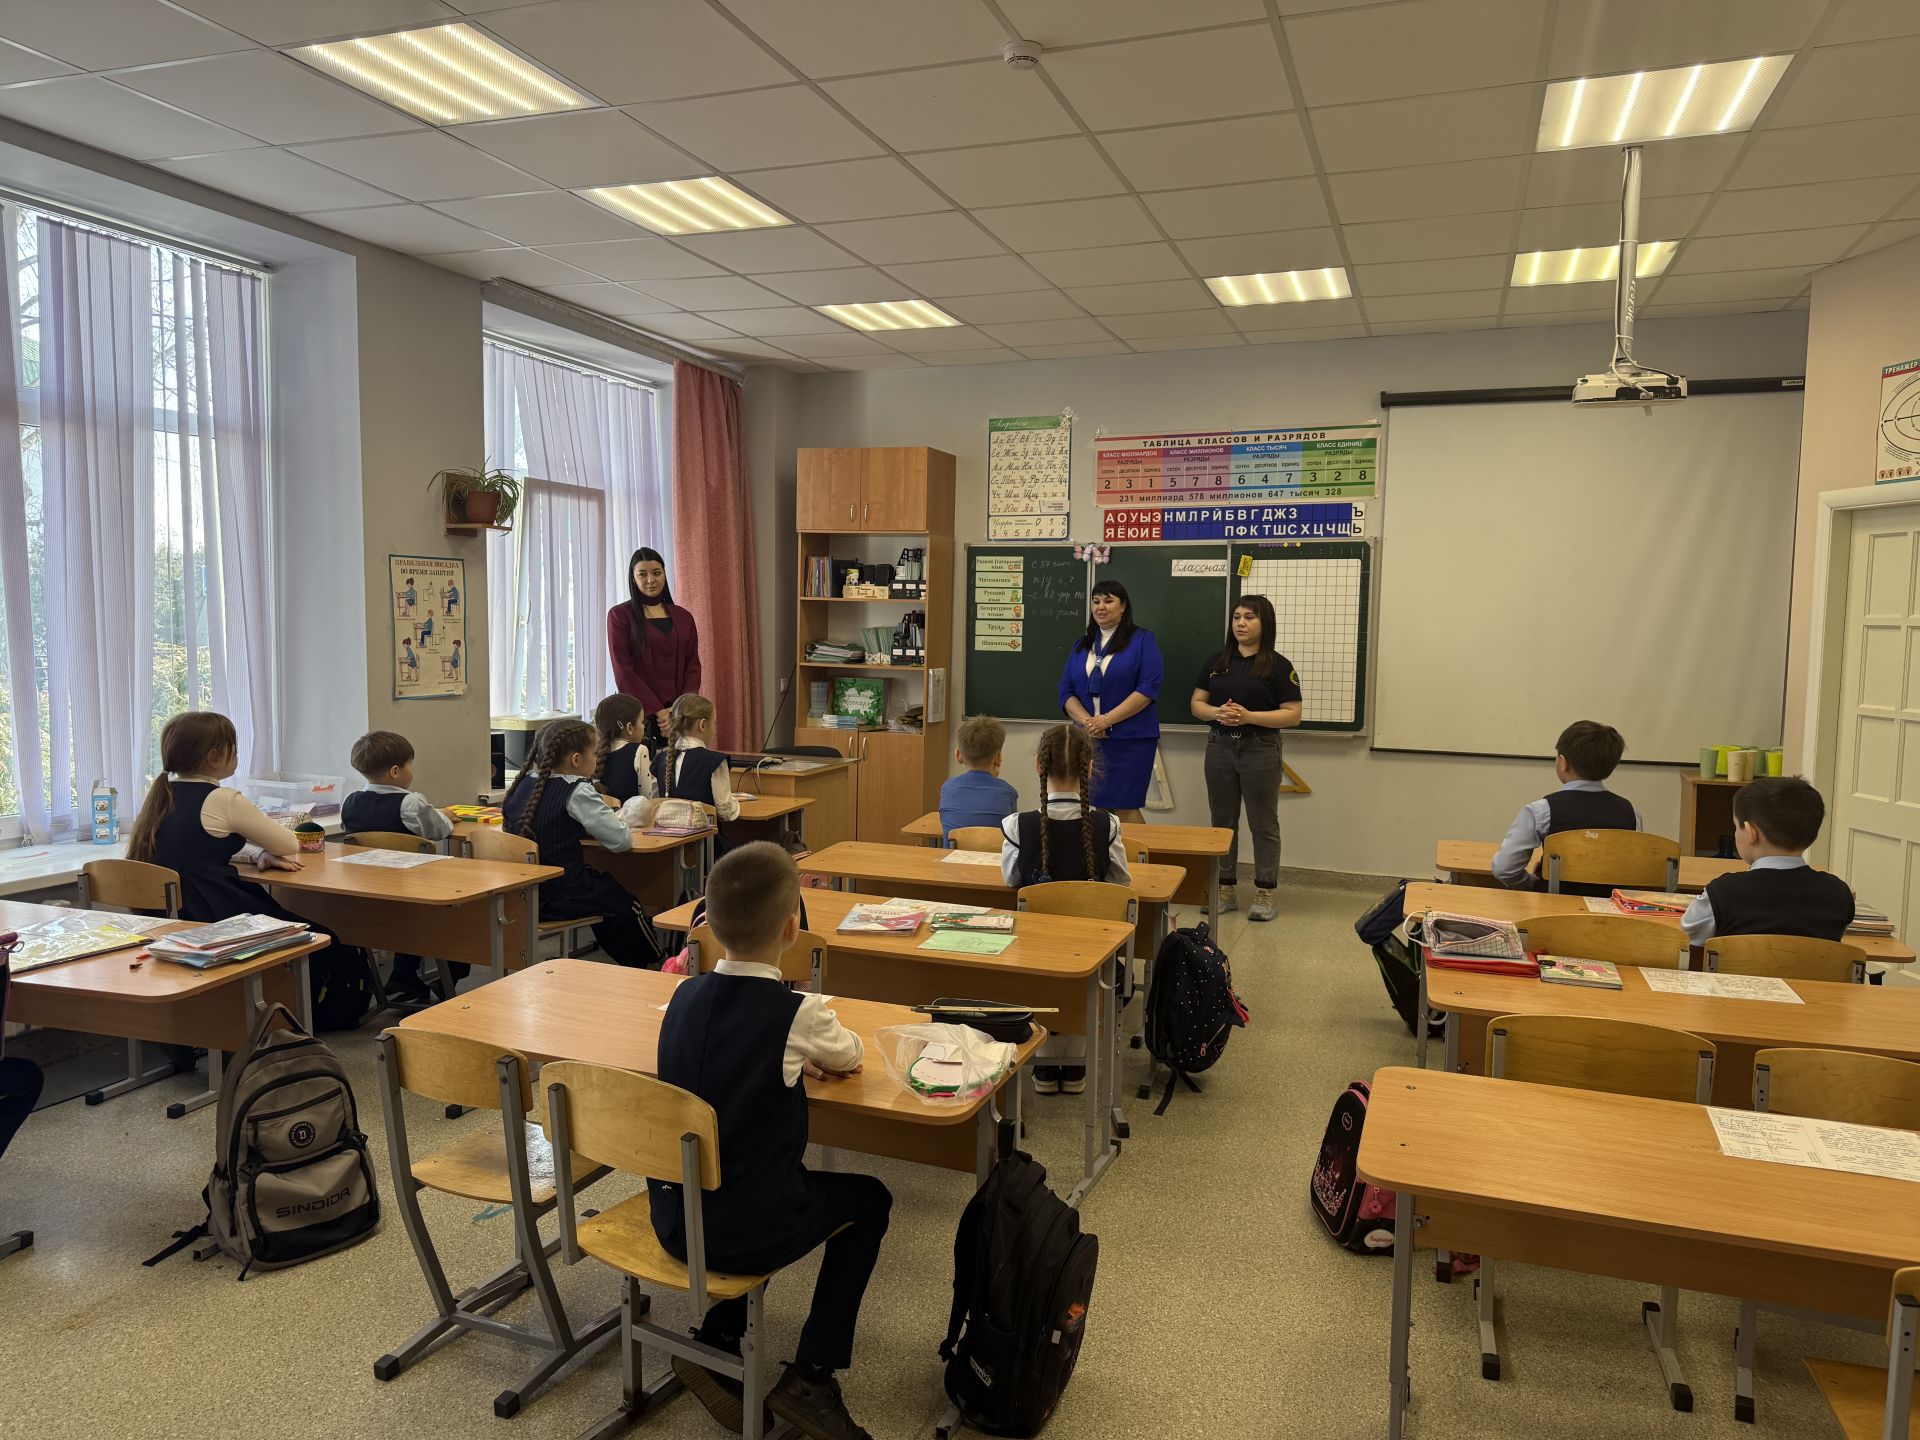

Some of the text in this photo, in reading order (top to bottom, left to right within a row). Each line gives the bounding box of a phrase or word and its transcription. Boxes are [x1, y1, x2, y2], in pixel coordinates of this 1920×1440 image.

[1143, 439, 1191, 447] ТАБЛИЦА
[1197, 436, 1247, 445] КЛАССОВ
[1267, 433, 1326, 441] РАЗРЯДОВ
[1104, 470, 1366, 489] 2 3 1 5 7 8 6 4 7 3 2 8
[1189, 492, 1204, 500] 578
[1209, 490, 1263, 499] миллионов
[1268, 490, 1284, 498] 647
[395, 559, 433, 567] ПРАВИЛЬНАЯ
[276, 1187, 350, 1218] SINDIDA
